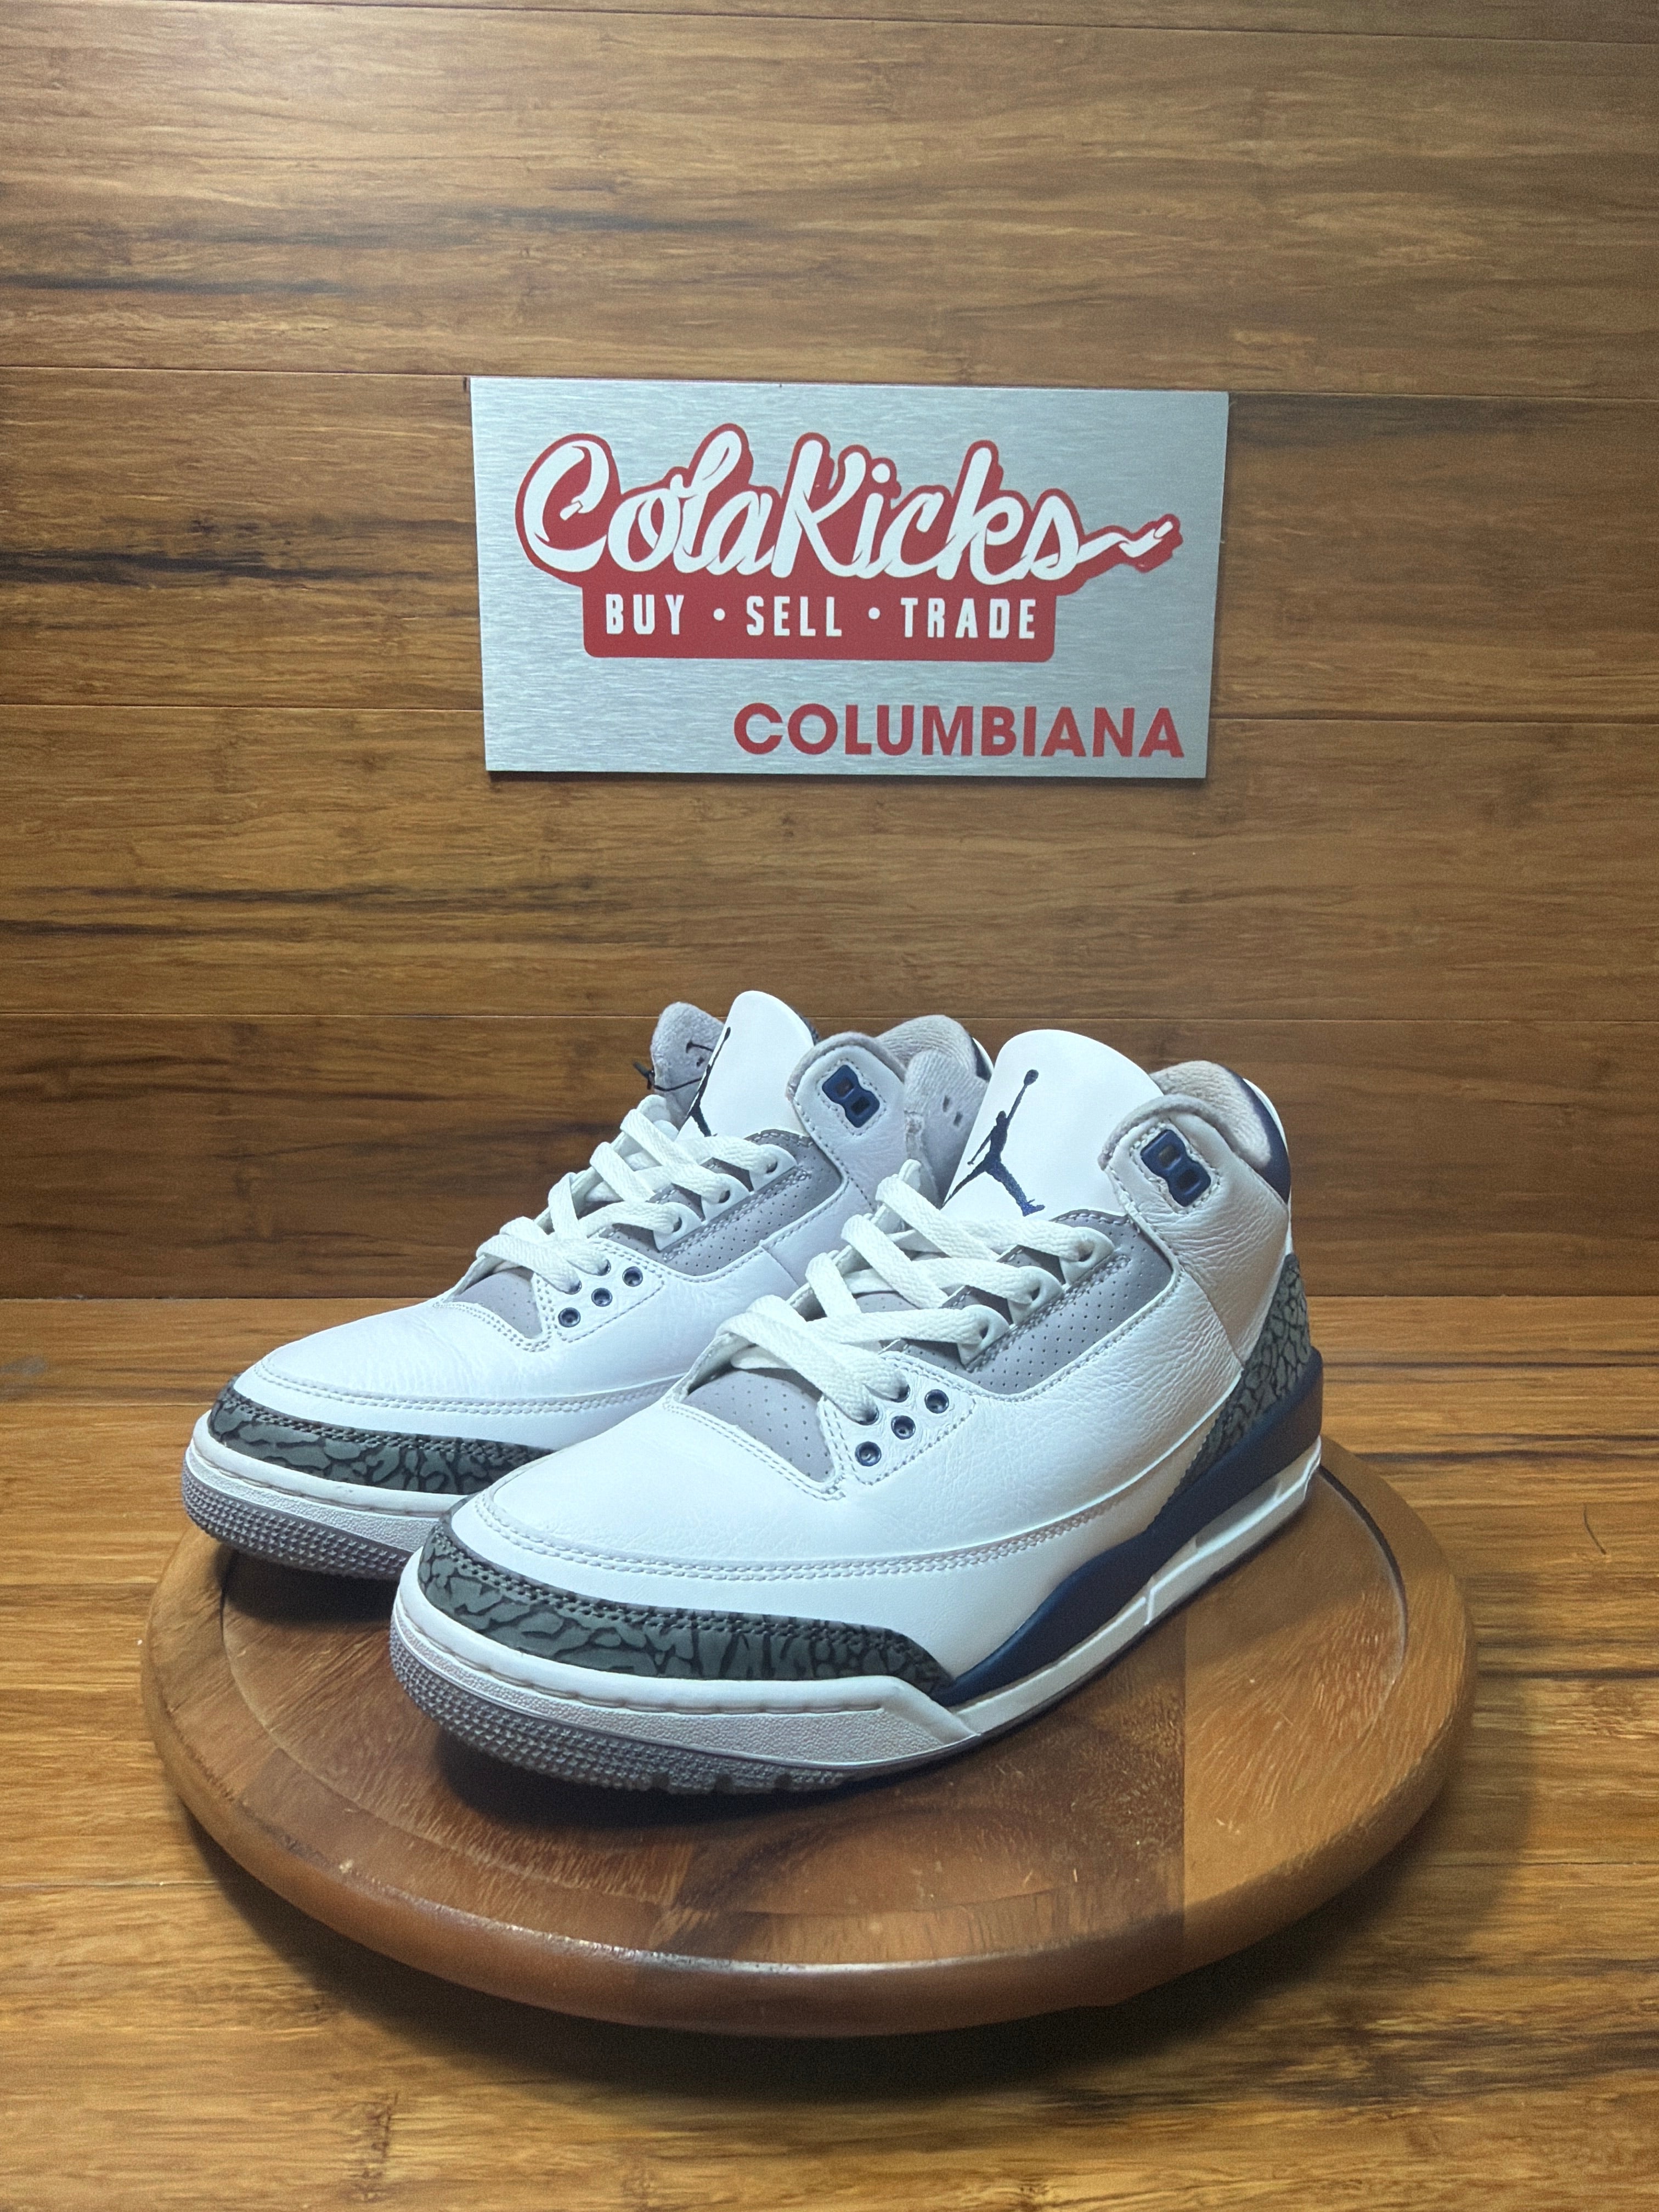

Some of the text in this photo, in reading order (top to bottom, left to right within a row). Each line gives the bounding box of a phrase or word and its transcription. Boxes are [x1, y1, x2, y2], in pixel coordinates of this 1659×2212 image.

[605, 593, 1037, 640] BUY SELL TRADE
[733, 703, 1185, 758] COLUMBIANA
